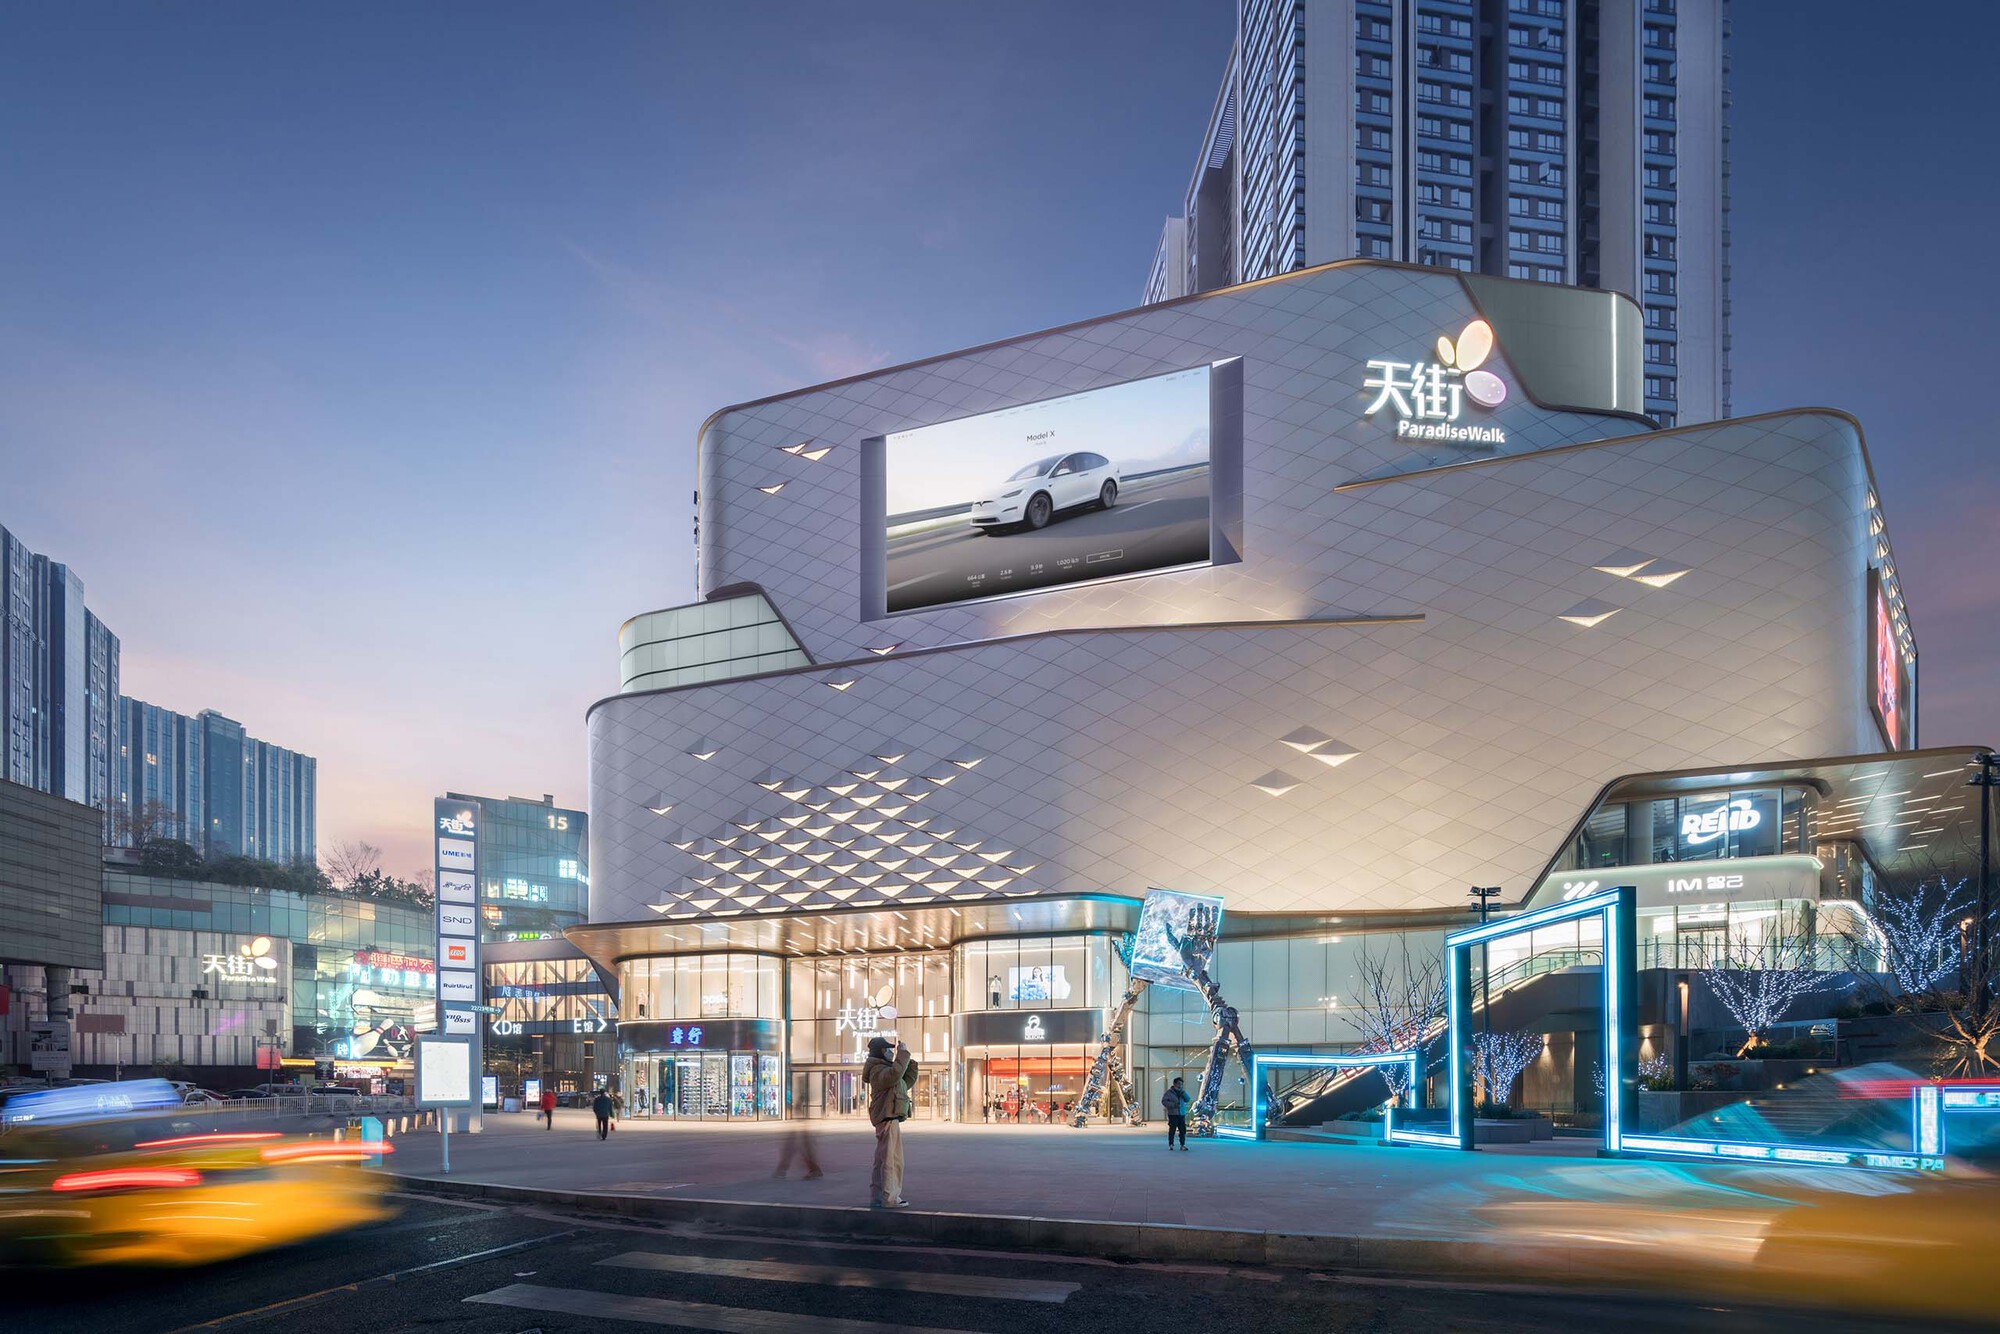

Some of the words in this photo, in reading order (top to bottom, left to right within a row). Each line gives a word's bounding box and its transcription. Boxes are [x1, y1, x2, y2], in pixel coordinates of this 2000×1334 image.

[1363, 359, 1463, 422] 天街
[1026, 431, 1049, 442] Model
[1049, 430, 1056, 438] X
[547, 815, 569, 830] 15
[1668, 878, 1703, 892] IM
[442, 915, 473, 925] SND
[202, 954, 255, 975] 天街
[573, 1018, 594, 1034] E馆
[838, 1008, 880, 1030] 天街
